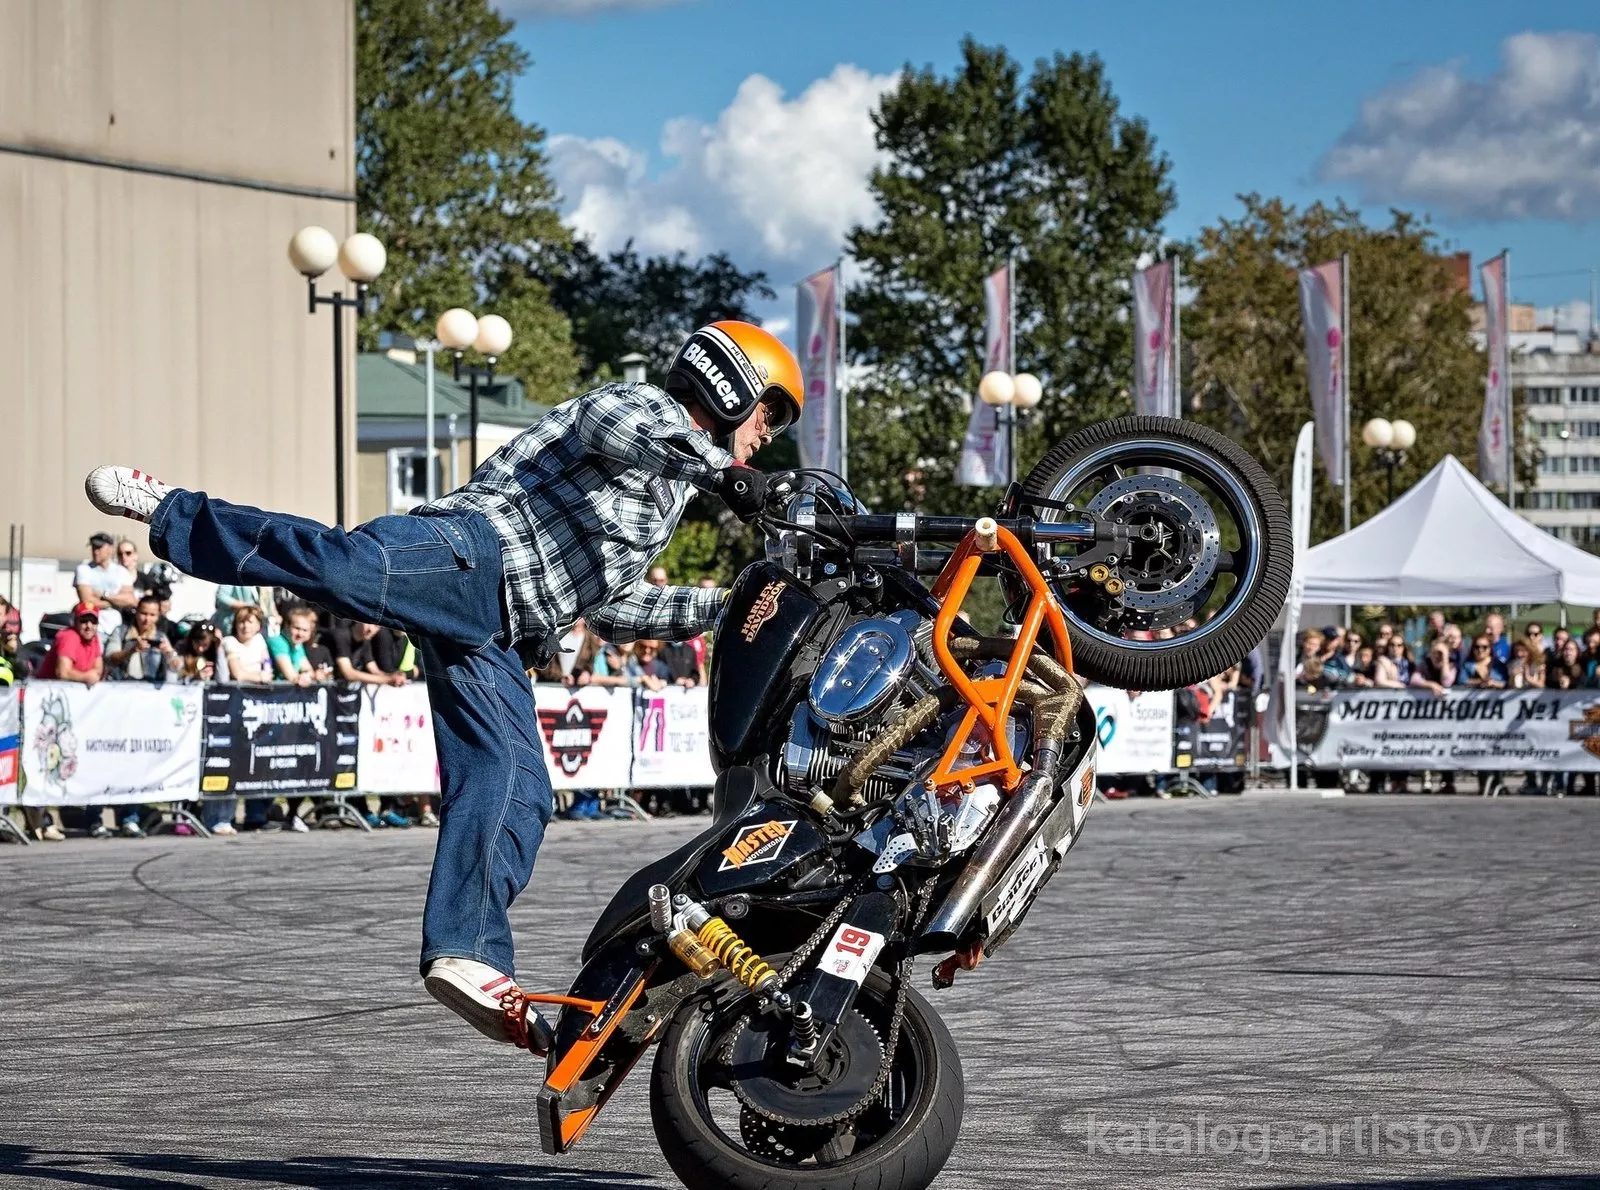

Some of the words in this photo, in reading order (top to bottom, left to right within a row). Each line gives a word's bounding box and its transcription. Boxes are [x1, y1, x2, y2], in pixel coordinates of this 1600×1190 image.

[745, 581, 787, 643] DAVIDSON
[1340, 699, 1505, 720] МОТОШКОЛА
[1516, 699, 1561, 720] №1
[721, 820, 794, 869] MASTER
[745, 836, 784, 863] МОТОШКОЛА
[835, 928, 871, 957] 19
